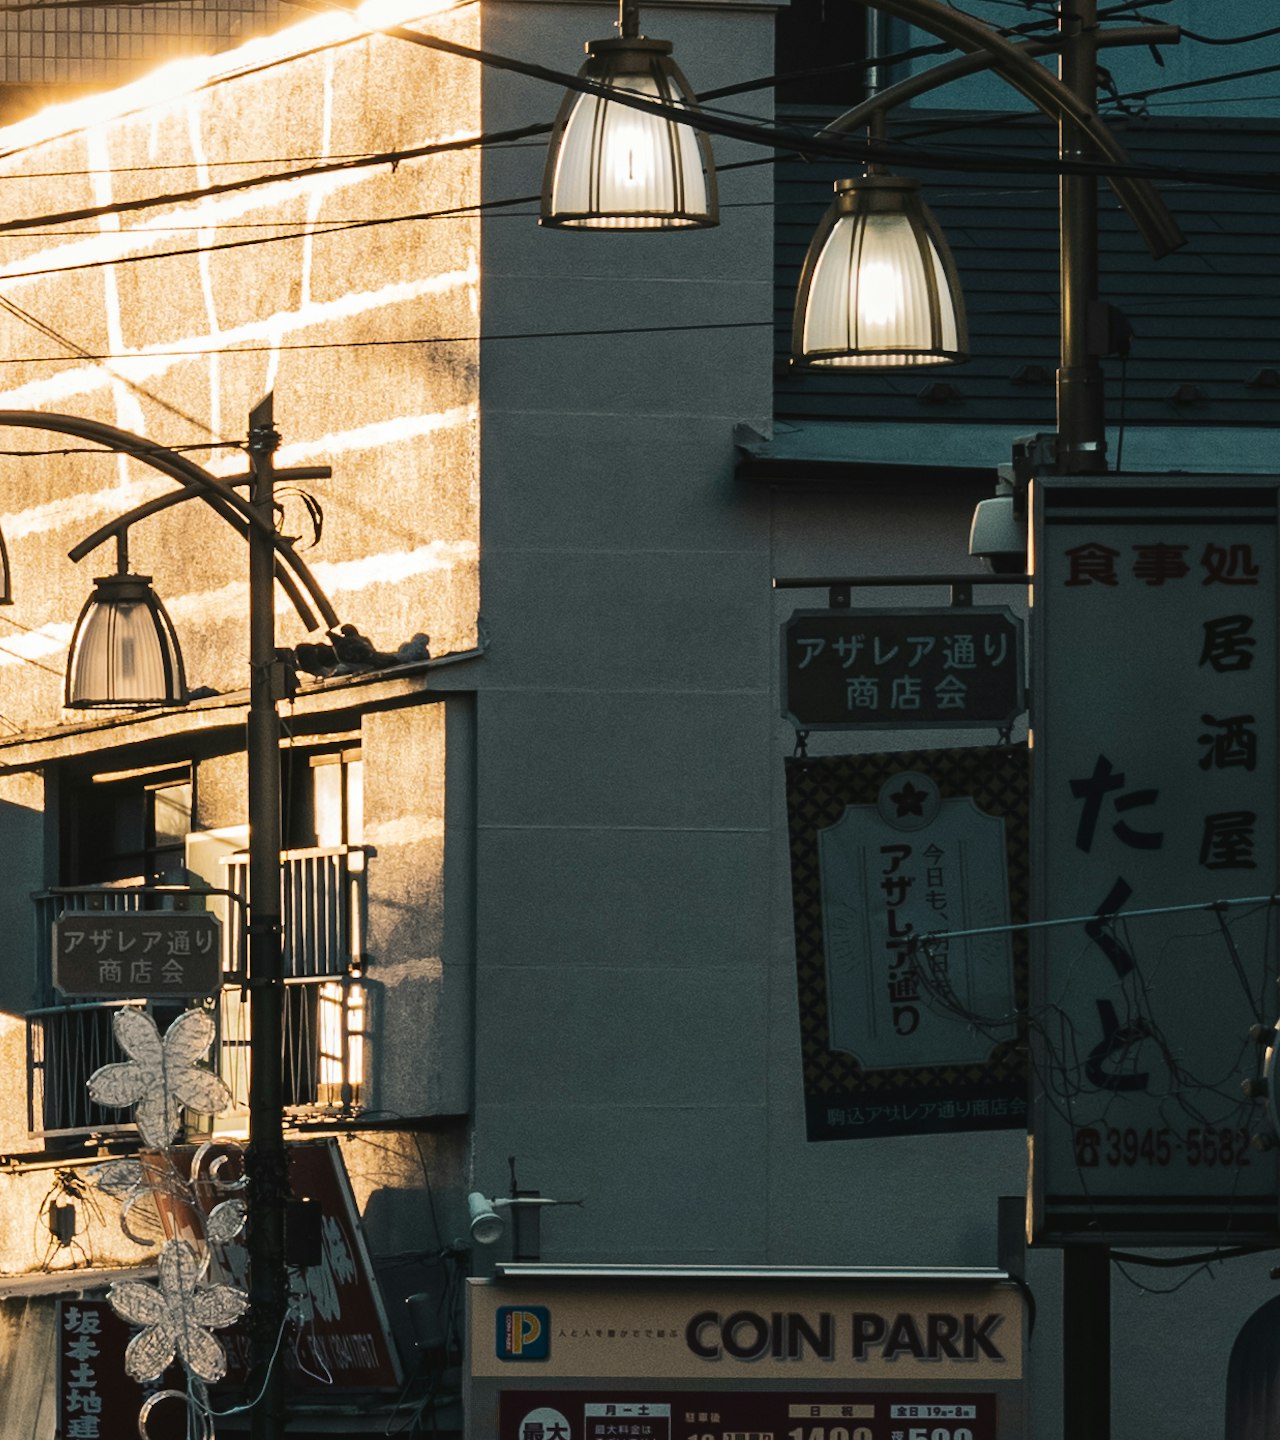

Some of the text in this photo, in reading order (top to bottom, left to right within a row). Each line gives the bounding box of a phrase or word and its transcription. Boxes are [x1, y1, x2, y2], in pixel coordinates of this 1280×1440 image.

[1065, 542, 1260, 587] 食事処
[796, 633, 1009, 671] アザレア通り
[846, 675, 969, 711] 商店会
[1197, 615, 1257, 870] 居酒屋
[64, 929, 212, 955] アザレア通り
[880, 844, 921, 1036] アザレア通り
[1069, 753, 1164, 1091] たくと
[98, 958, 184, 984] 商店会
[686, 1311, 1005, 1362] COIN PARK
[595, 1424, 653, 1435] 最大料金は
